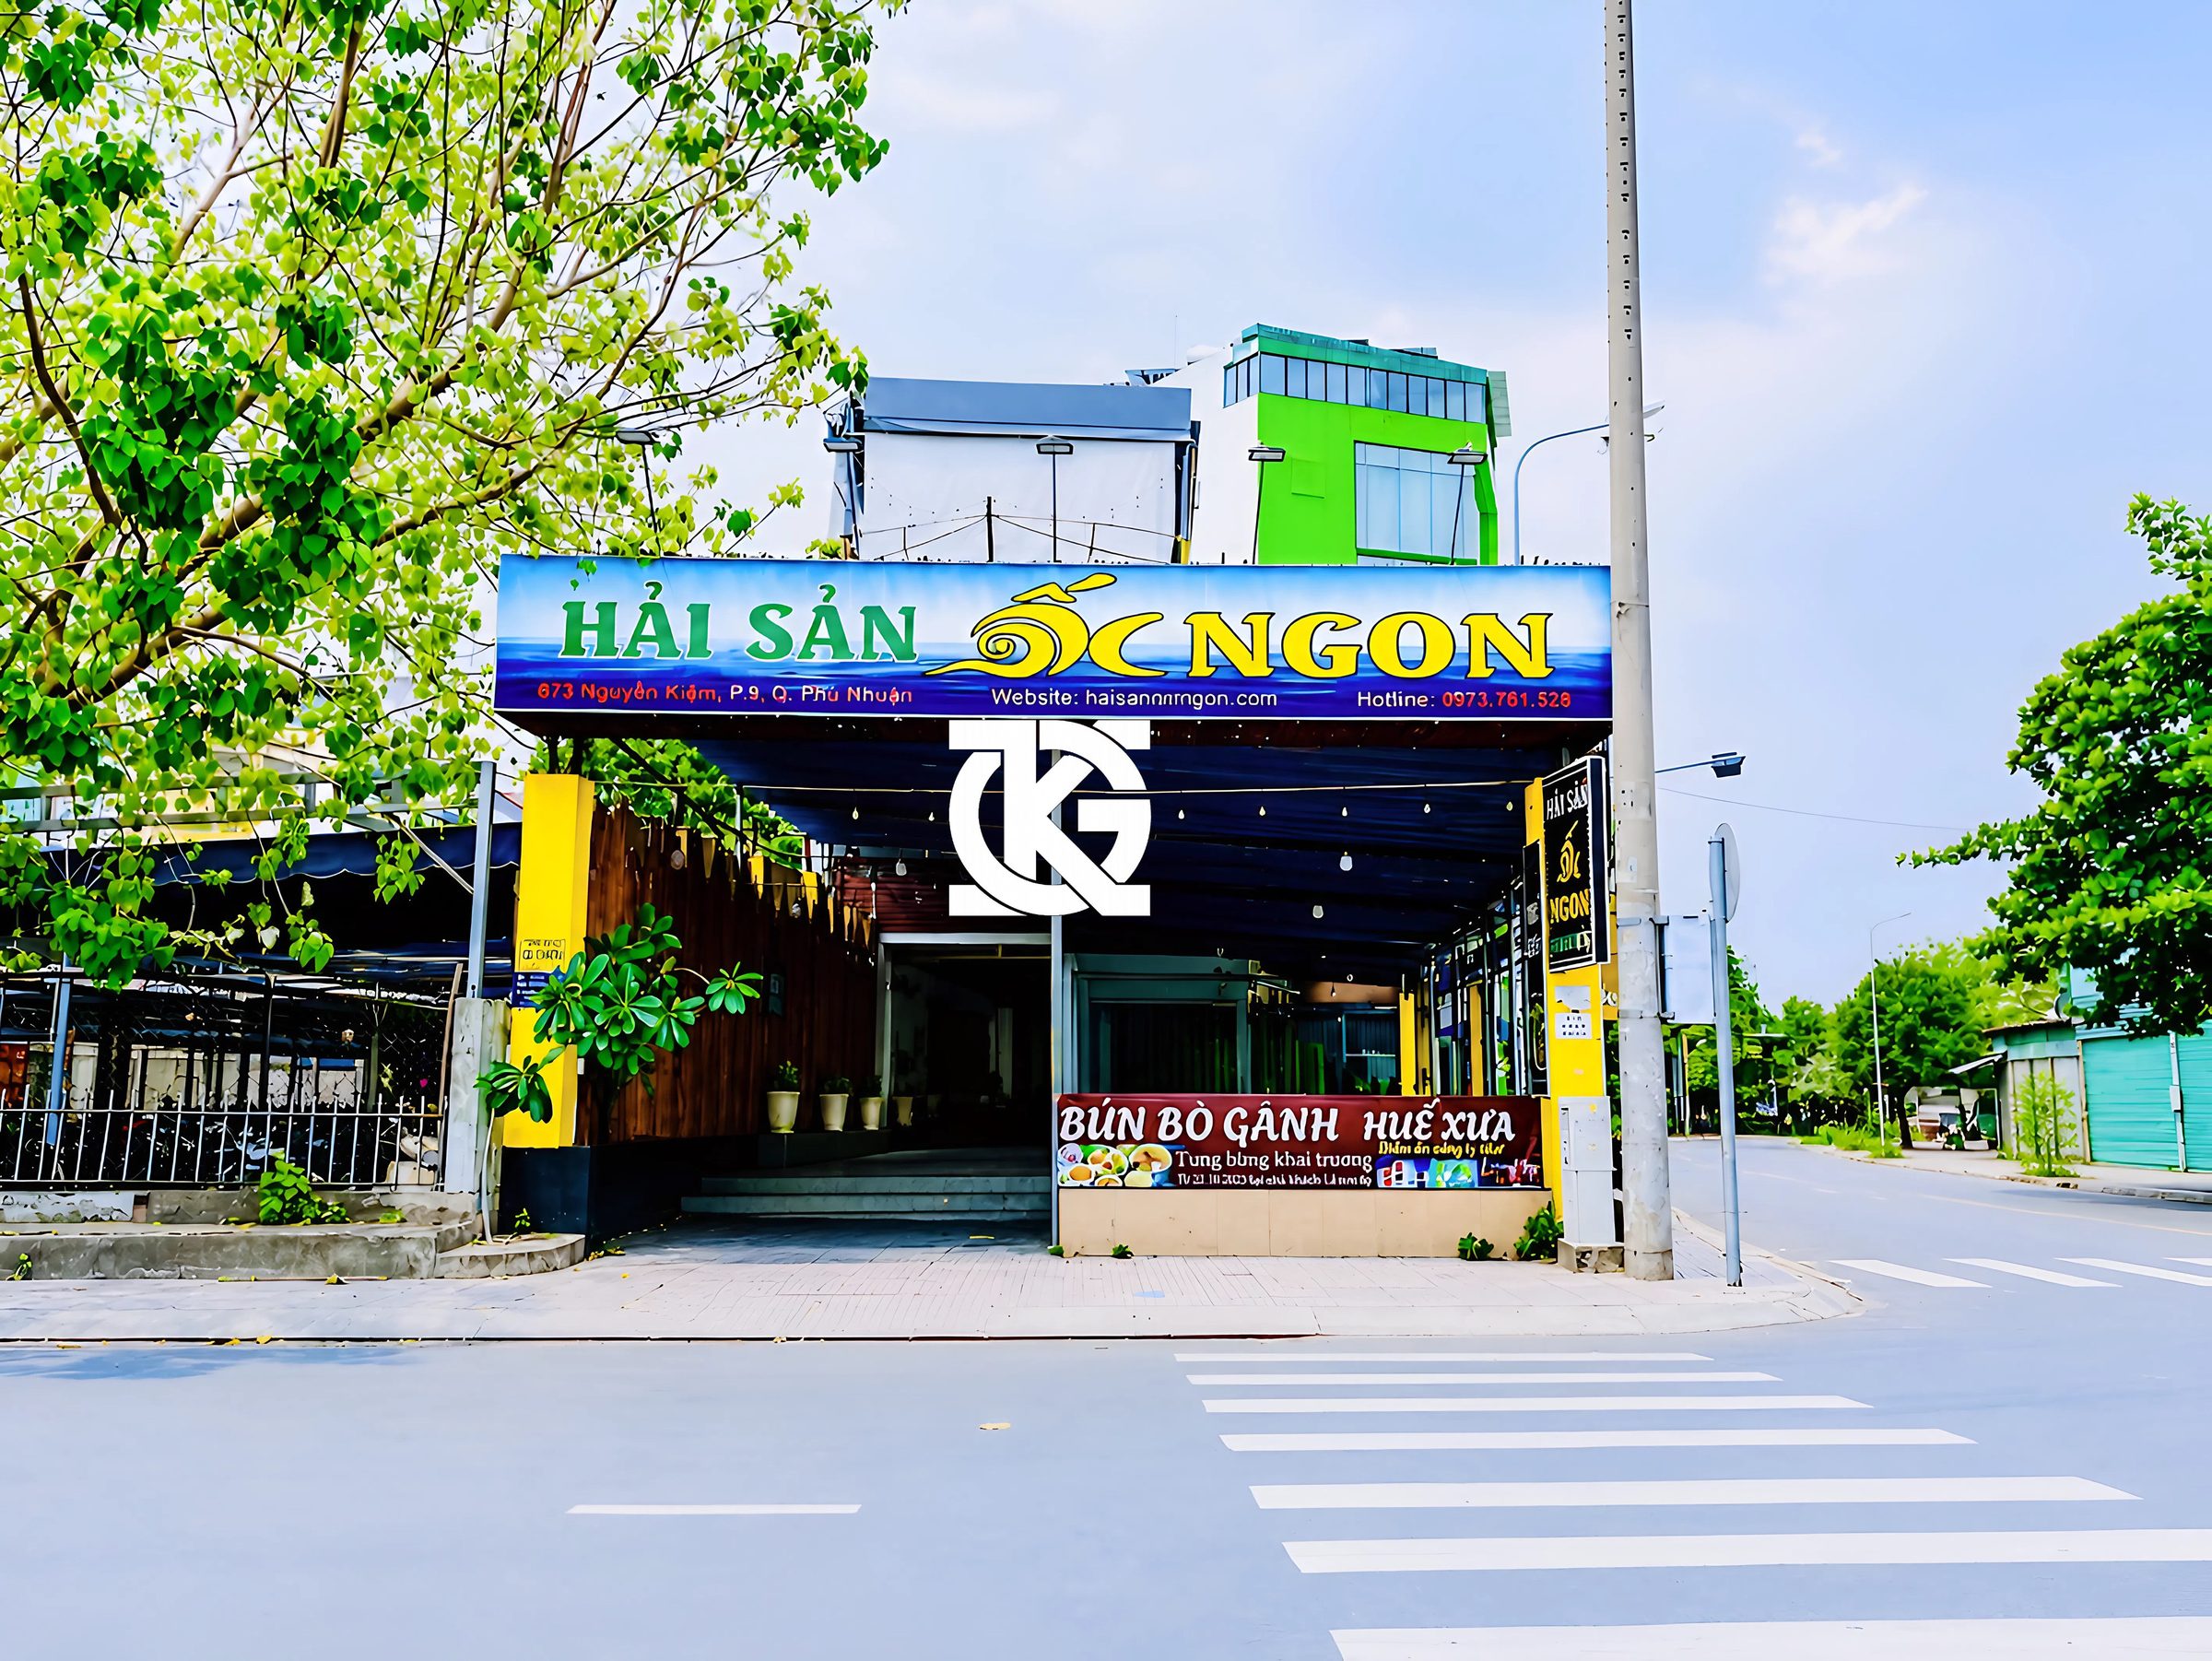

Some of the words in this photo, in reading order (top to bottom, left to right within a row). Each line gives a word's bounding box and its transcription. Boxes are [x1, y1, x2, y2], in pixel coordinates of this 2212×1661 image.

[558, 581, 712, 660] HẢI
[746, 584, 918, 663] SẢN
[1184, 610, 1557, 679] NGON
[802, 685, 839, 701] Phú
[992, 688, 1078, 705] Website:
[1358, 690, 1435, 707] Hotline:
[1549, 889, 1590, 924] NGON
[1060, 1098, 1146, 1141] BÚN
[1157, 1101, 1214, 1141] BÒ
[1363, 1098, 1441, 1141] HUẾ
[1441, 1109, 1516, 1142] XƯA
[1274, 1150, 1312, 1167] khai
